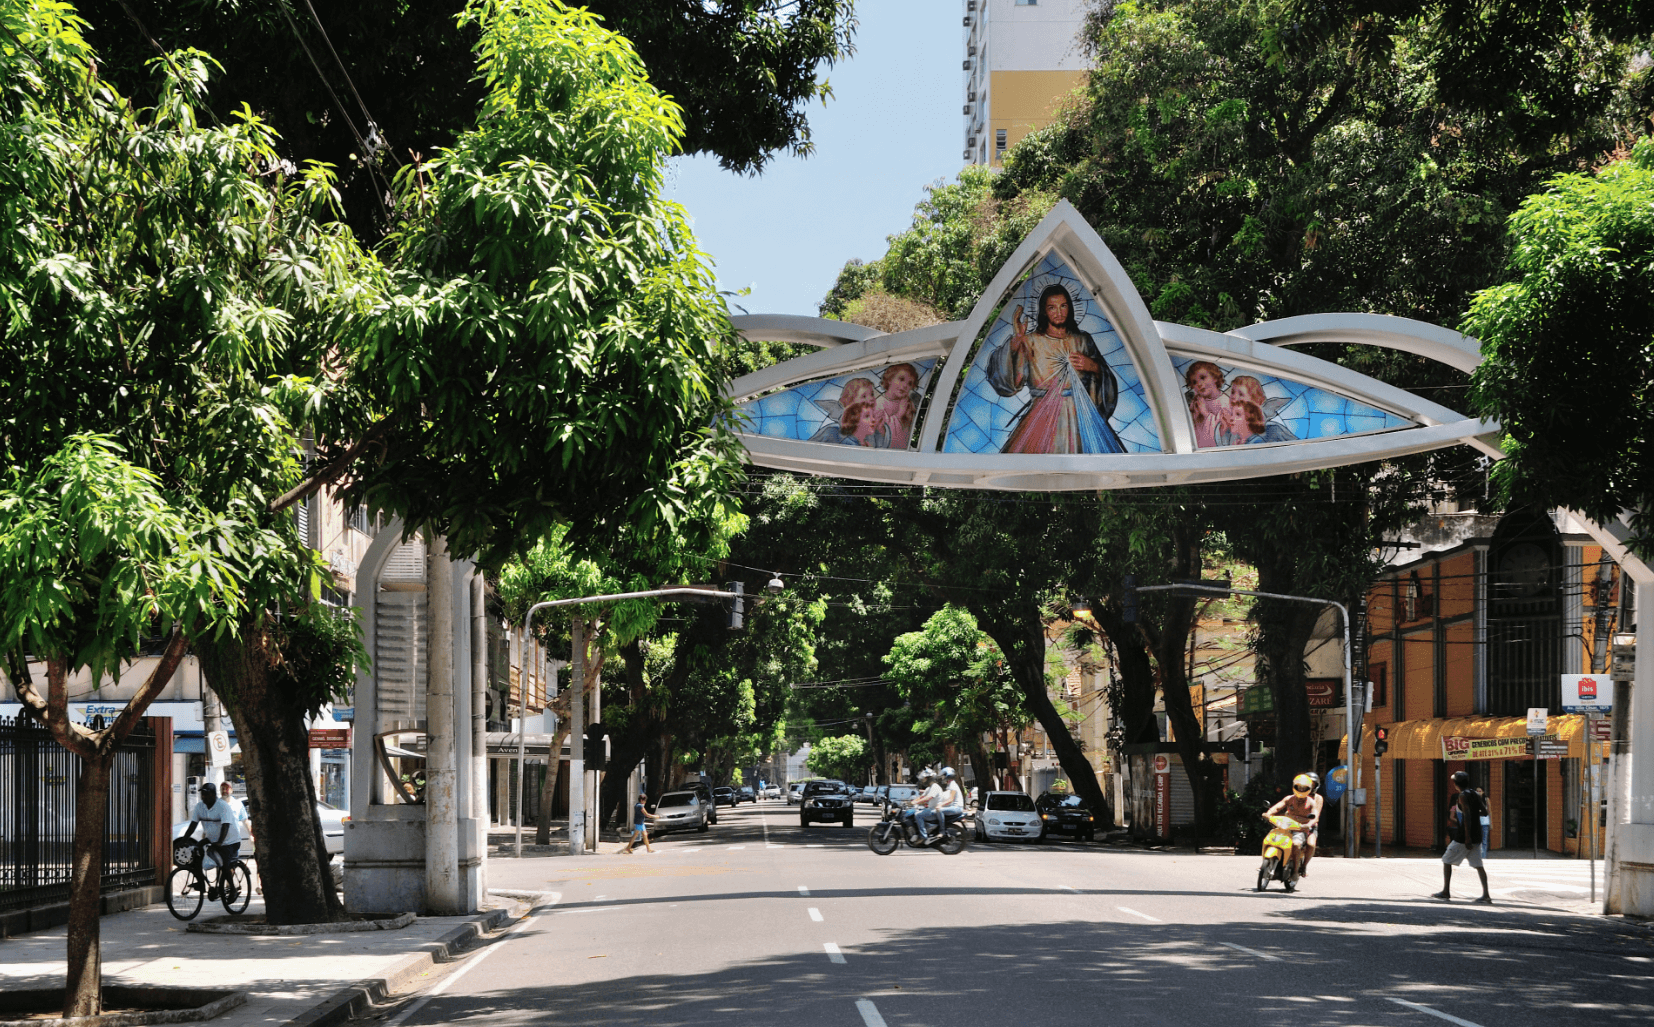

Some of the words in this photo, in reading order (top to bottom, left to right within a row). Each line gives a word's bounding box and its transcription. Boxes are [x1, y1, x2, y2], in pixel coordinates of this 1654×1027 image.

[1310, 697, 1332, 705] ZARÉ
[86, 705, 116, 714] Extra
[1444, 738, 1470, 751] BIG
